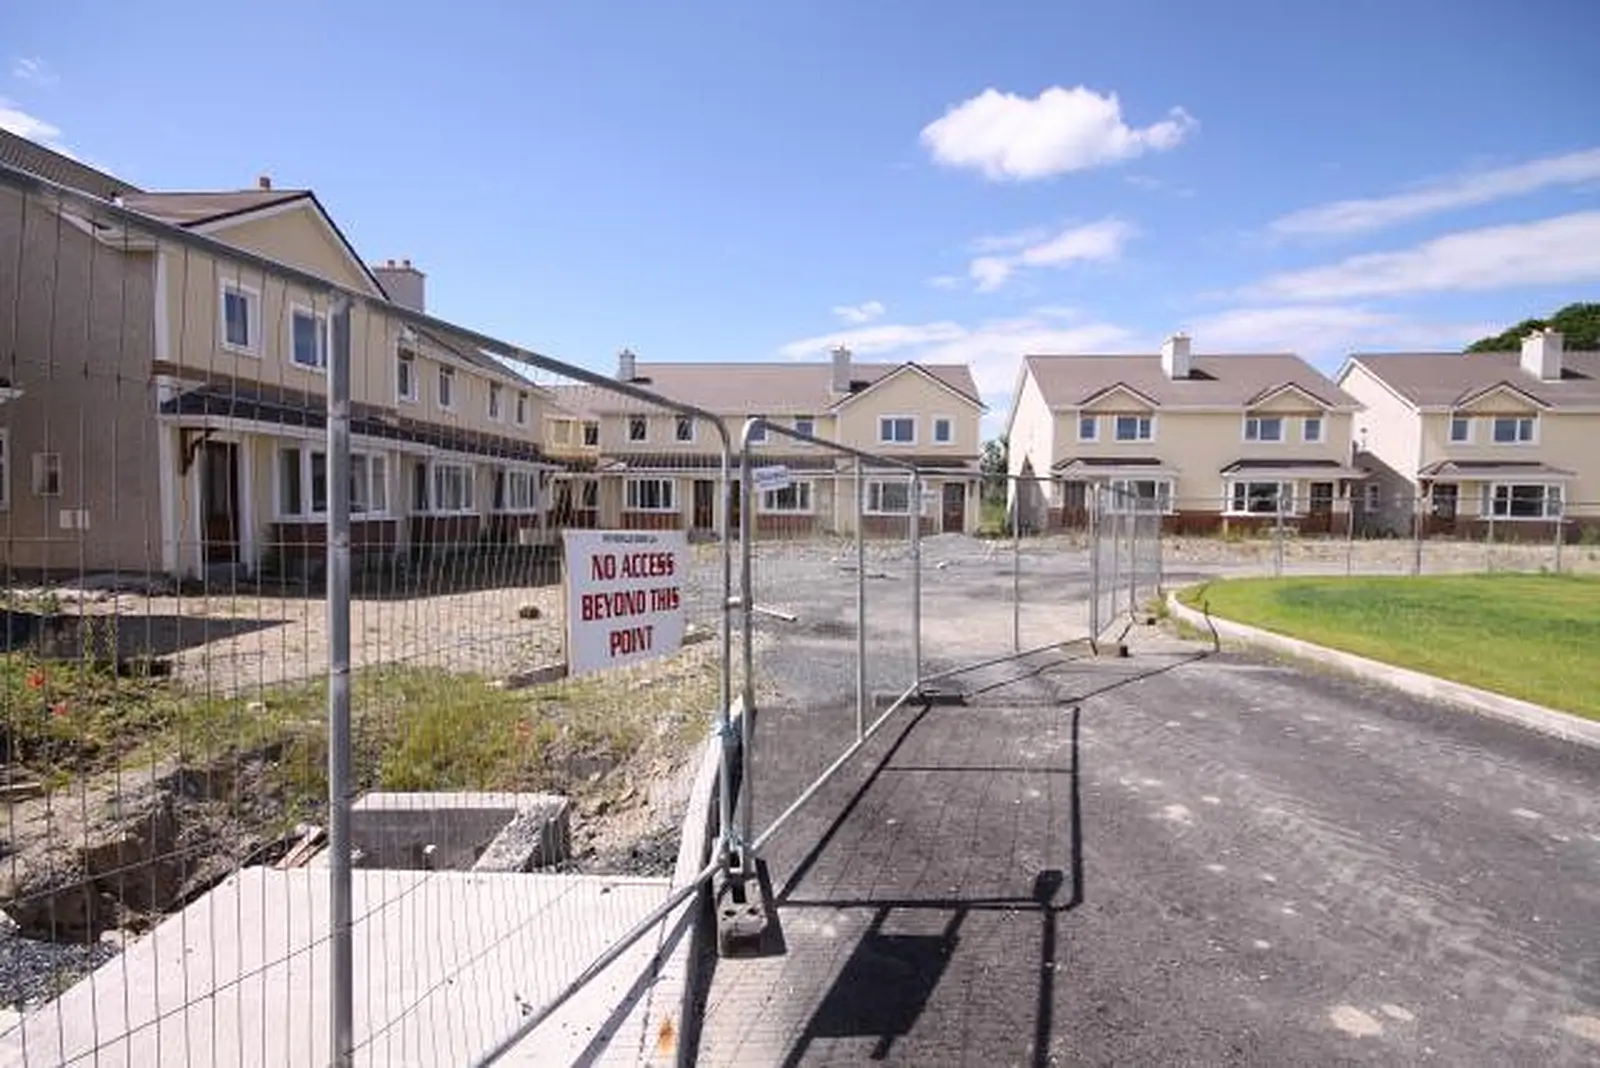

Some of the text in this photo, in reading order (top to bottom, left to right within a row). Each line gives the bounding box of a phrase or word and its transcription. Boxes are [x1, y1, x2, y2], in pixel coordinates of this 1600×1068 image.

[592, 552, 675, 580] NO ACCESS
[582, 587, 680, 621] BEYOND THIS
[610, 625, 653, 657] POINT
